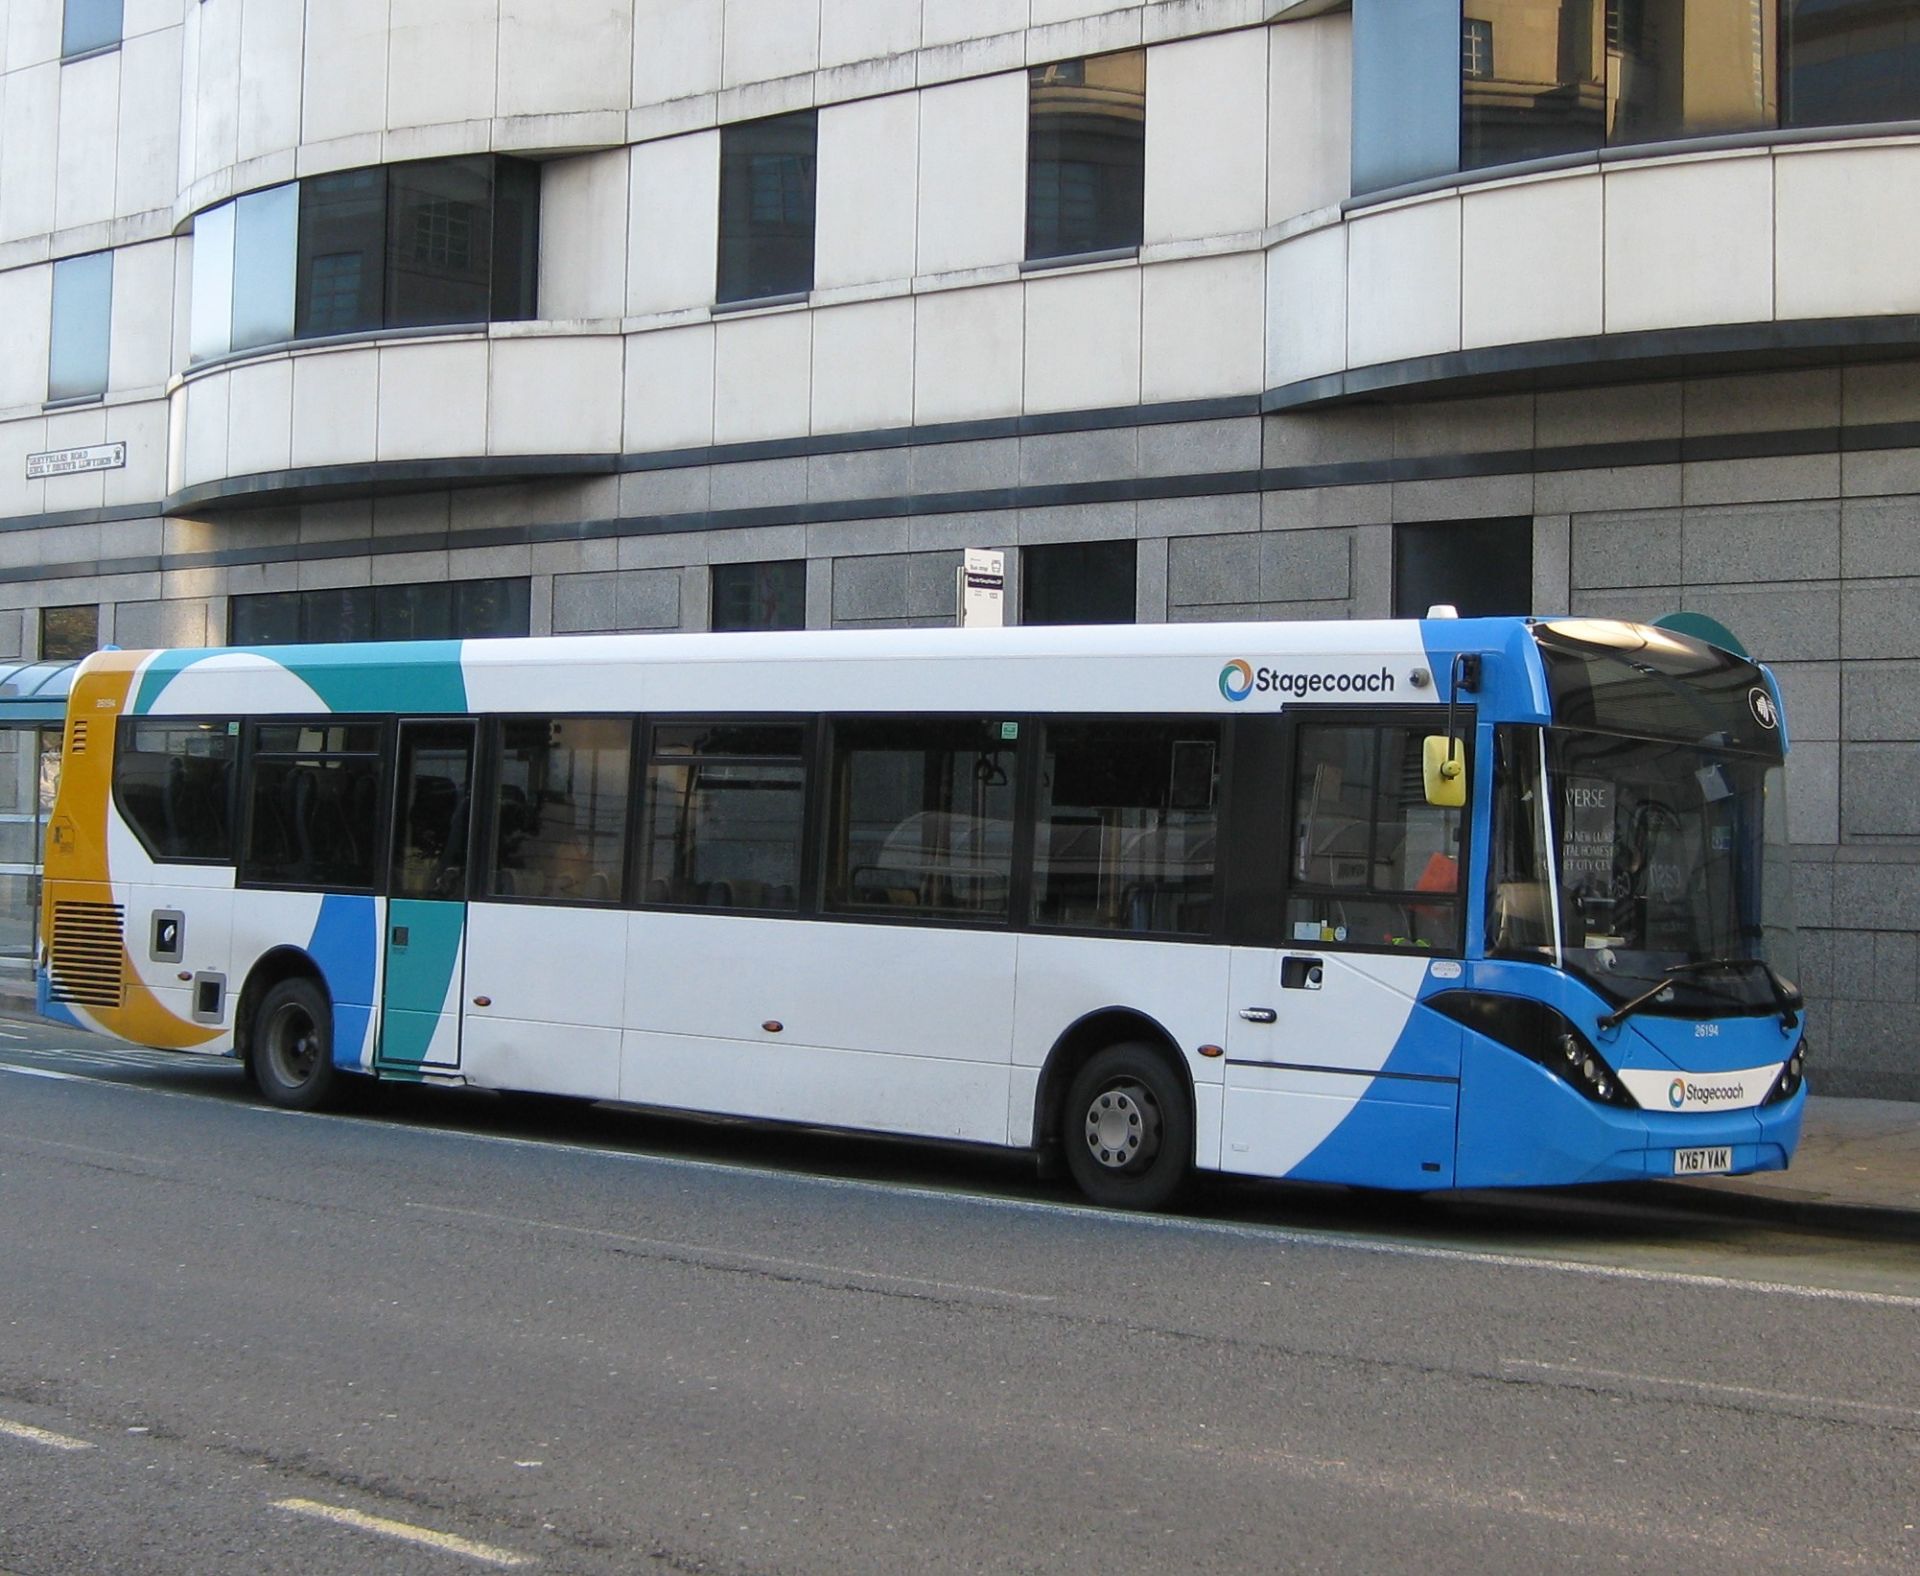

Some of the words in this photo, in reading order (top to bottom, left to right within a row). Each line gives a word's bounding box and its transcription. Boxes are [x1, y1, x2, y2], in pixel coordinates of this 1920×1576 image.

[1255, 667, 1395, 697] Stagecoach
[1694, 1024, 1719, 1037] 26194
[1686, 1083, 1744, 1104] Stagecoach
[1679, 1151, 1706, 1170] YX67
[1707, 1150, 1727, 1168] VAK
